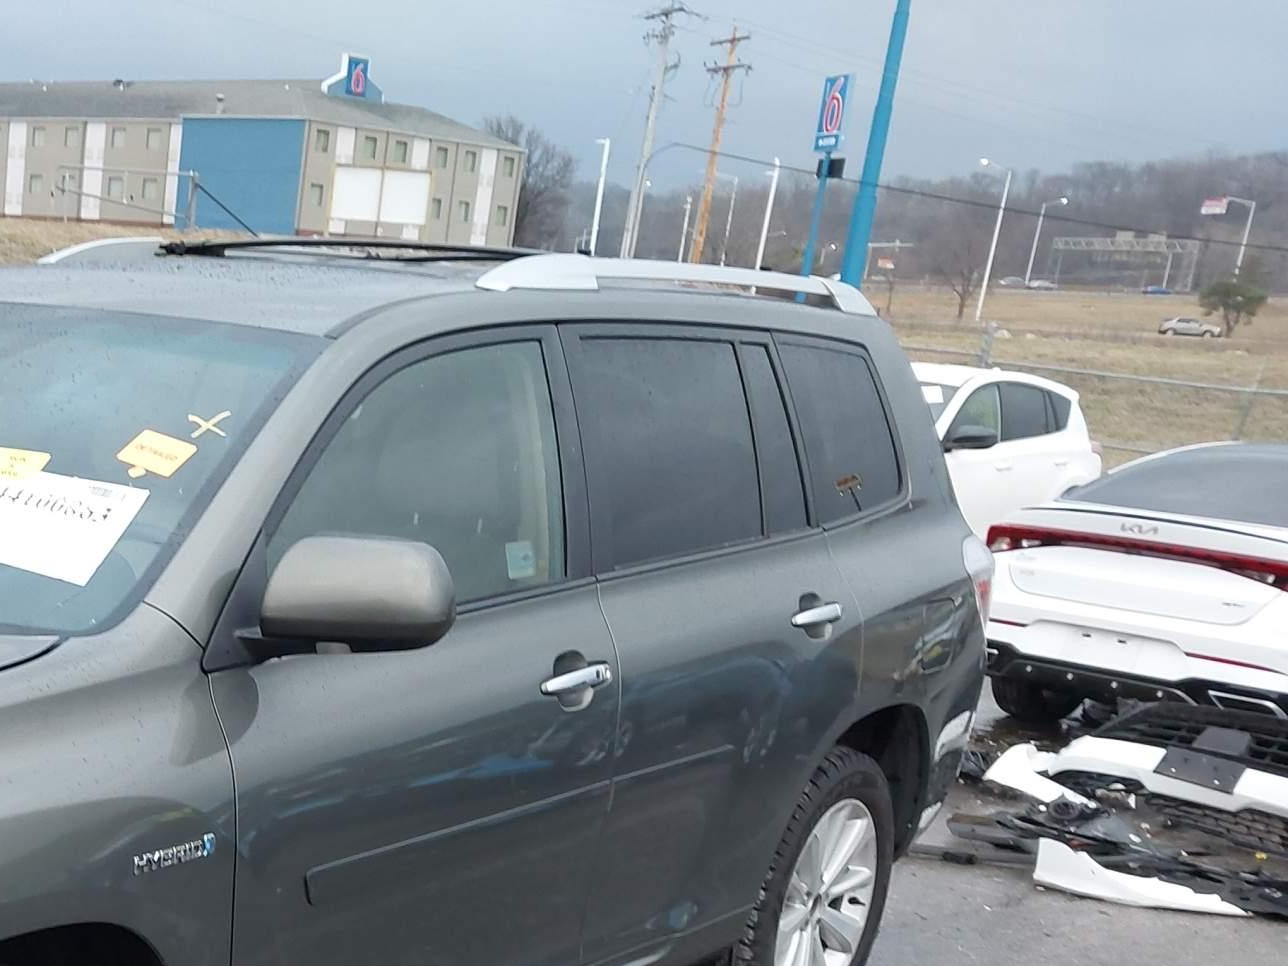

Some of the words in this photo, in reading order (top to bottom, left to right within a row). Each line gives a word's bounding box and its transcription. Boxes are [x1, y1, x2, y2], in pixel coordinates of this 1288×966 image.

[351, 63, 365, 95] 6
[823, 76, 844, 135] 6
[133, 840, 203, 876] HYBRID
